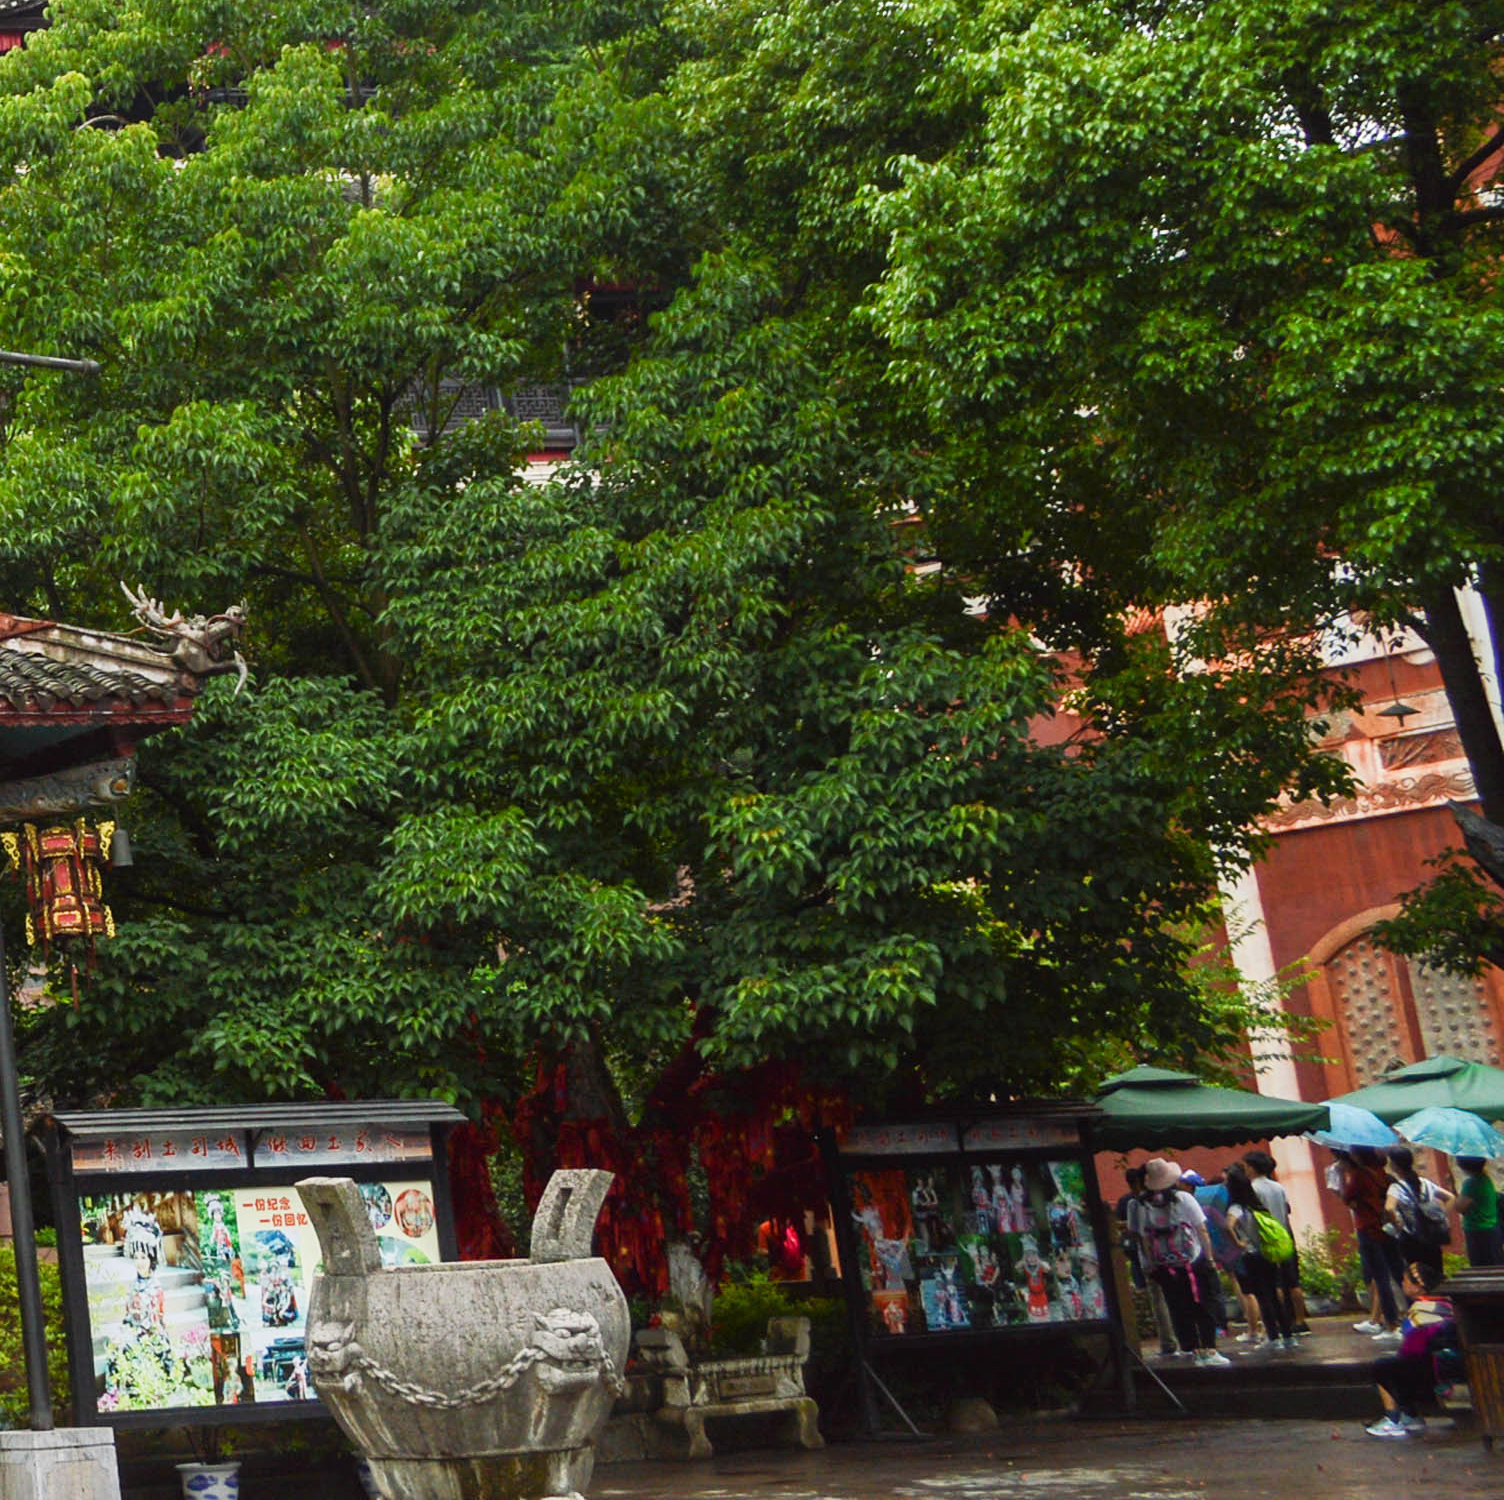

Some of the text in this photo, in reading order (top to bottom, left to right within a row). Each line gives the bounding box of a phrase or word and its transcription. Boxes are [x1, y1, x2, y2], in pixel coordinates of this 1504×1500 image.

[242, 1196, 291, 1211] 一份纪念
[259, 1212, 308, 1227] 一份回忆
